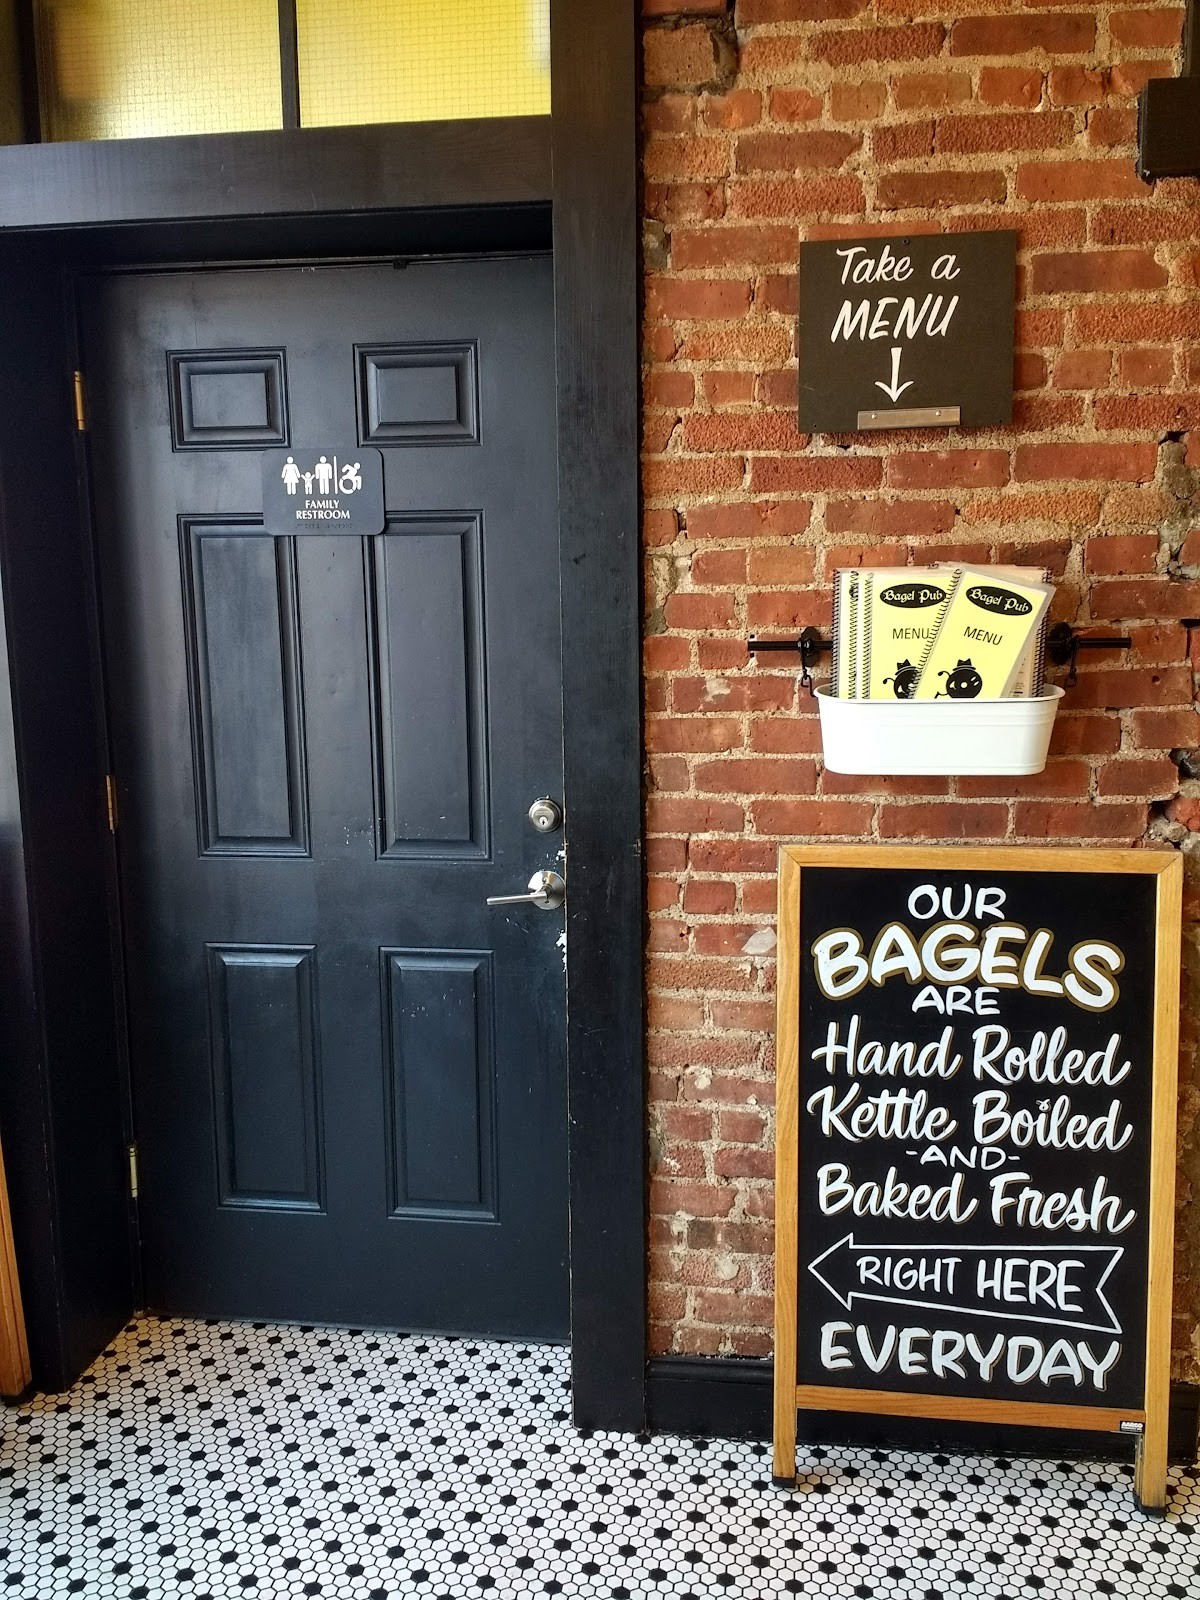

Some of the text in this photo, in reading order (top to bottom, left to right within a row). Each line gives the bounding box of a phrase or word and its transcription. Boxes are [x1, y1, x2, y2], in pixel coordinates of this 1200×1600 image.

[836, 244, 961, 285] Take a
[830, 293, 959, 343] MENU
[296, 510, 350, 520] RESTROOM
[305, 499, 340, 509] FAMILY
[883, 588, 943, 602] Bagel Pub
[969, 588, 1029, 613] Bagel Pub
[892, 627, 930, 640] MENU
[963, 625, 1003, 646] MENU
[907, 883, 1007, 920] OUR
[811, 921, 1126, 1012] BAGELS
[912, 985, 1001, 1016] ARE
[811, 1014, 1132, 1086] Hand Rolled
[806, 1082, 1134, 1151] Kettle Boiled
[817, 1162, 1137, 1235] Baked Fresh
[856, 1256, 1085, 1313] RIGHT HERE
[820, 1320, 1122, 1391] EVERYDAY
